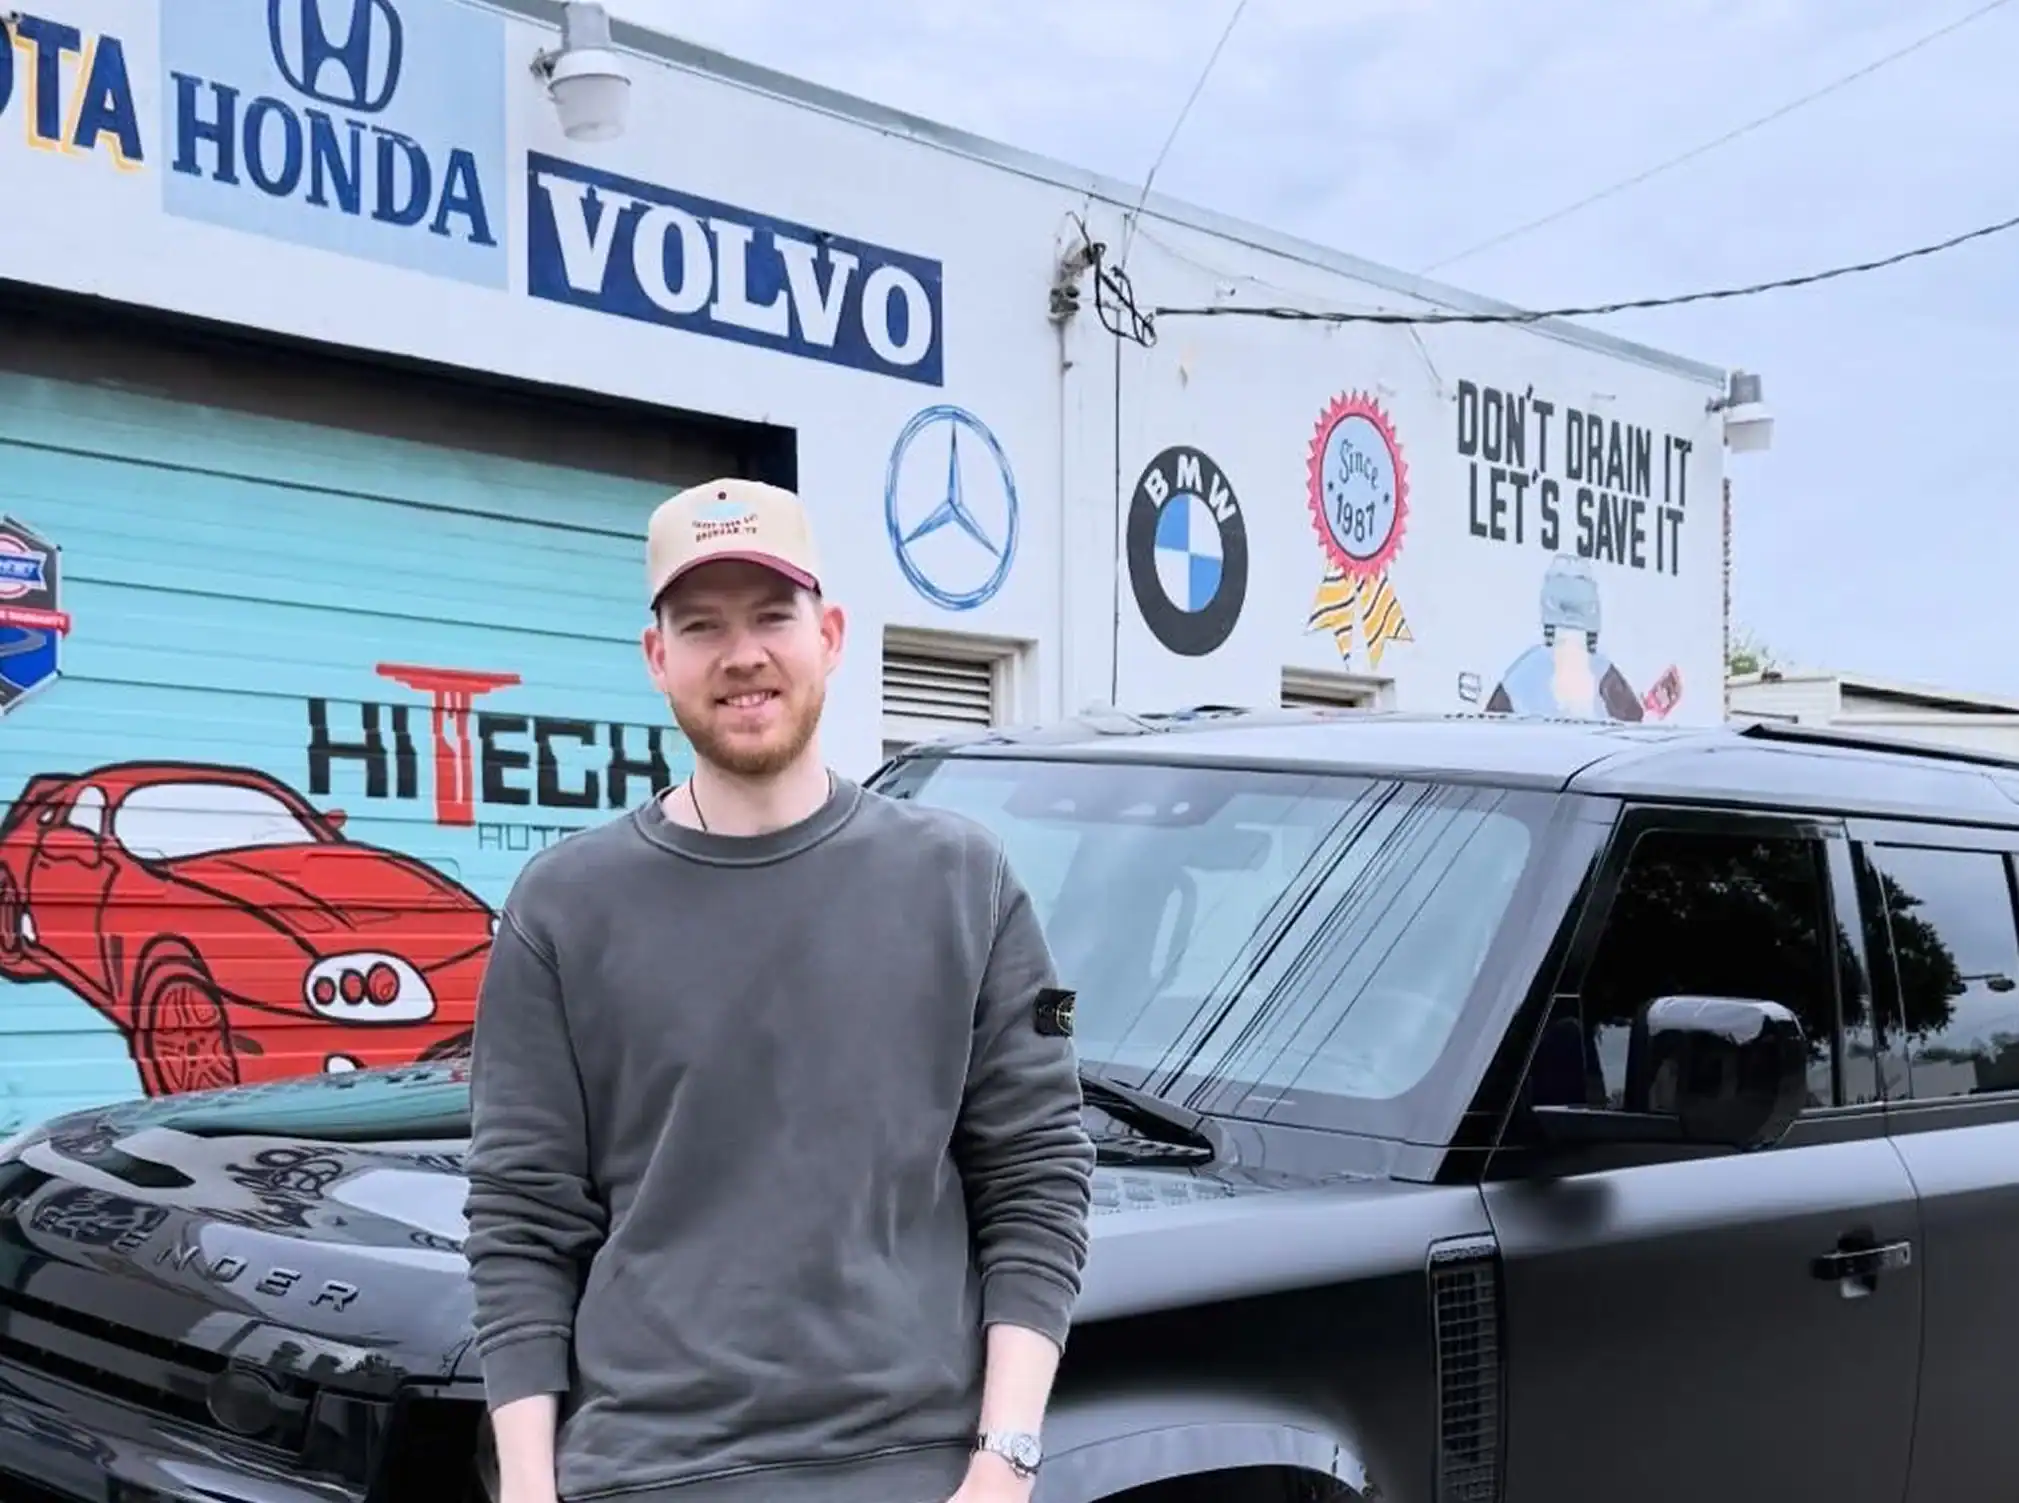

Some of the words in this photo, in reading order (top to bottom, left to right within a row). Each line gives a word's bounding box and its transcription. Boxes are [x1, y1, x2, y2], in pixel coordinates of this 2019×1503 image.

[0, 12, 146, 165] TA
[170, 70, 498, 247] HONDA
[537, 172, 933, 366] VOLVO
[1143, 453, 1237, 523] BMW
[1338, 438, 1379, 491] Since
[1458, 379, 1555, 473] DON'T
[1566, 407, 1652, 498] DRAIN
[1664, 433, 1693, 507] IT
[1336, 491, 1376, 542] 1987
[1469, 462, 1560, 552] LET'S
[1576, 487, 1646, 570] SAVE
[1657, 505, 1685, 577] IT
[477, 821, 588, 852] AUT
